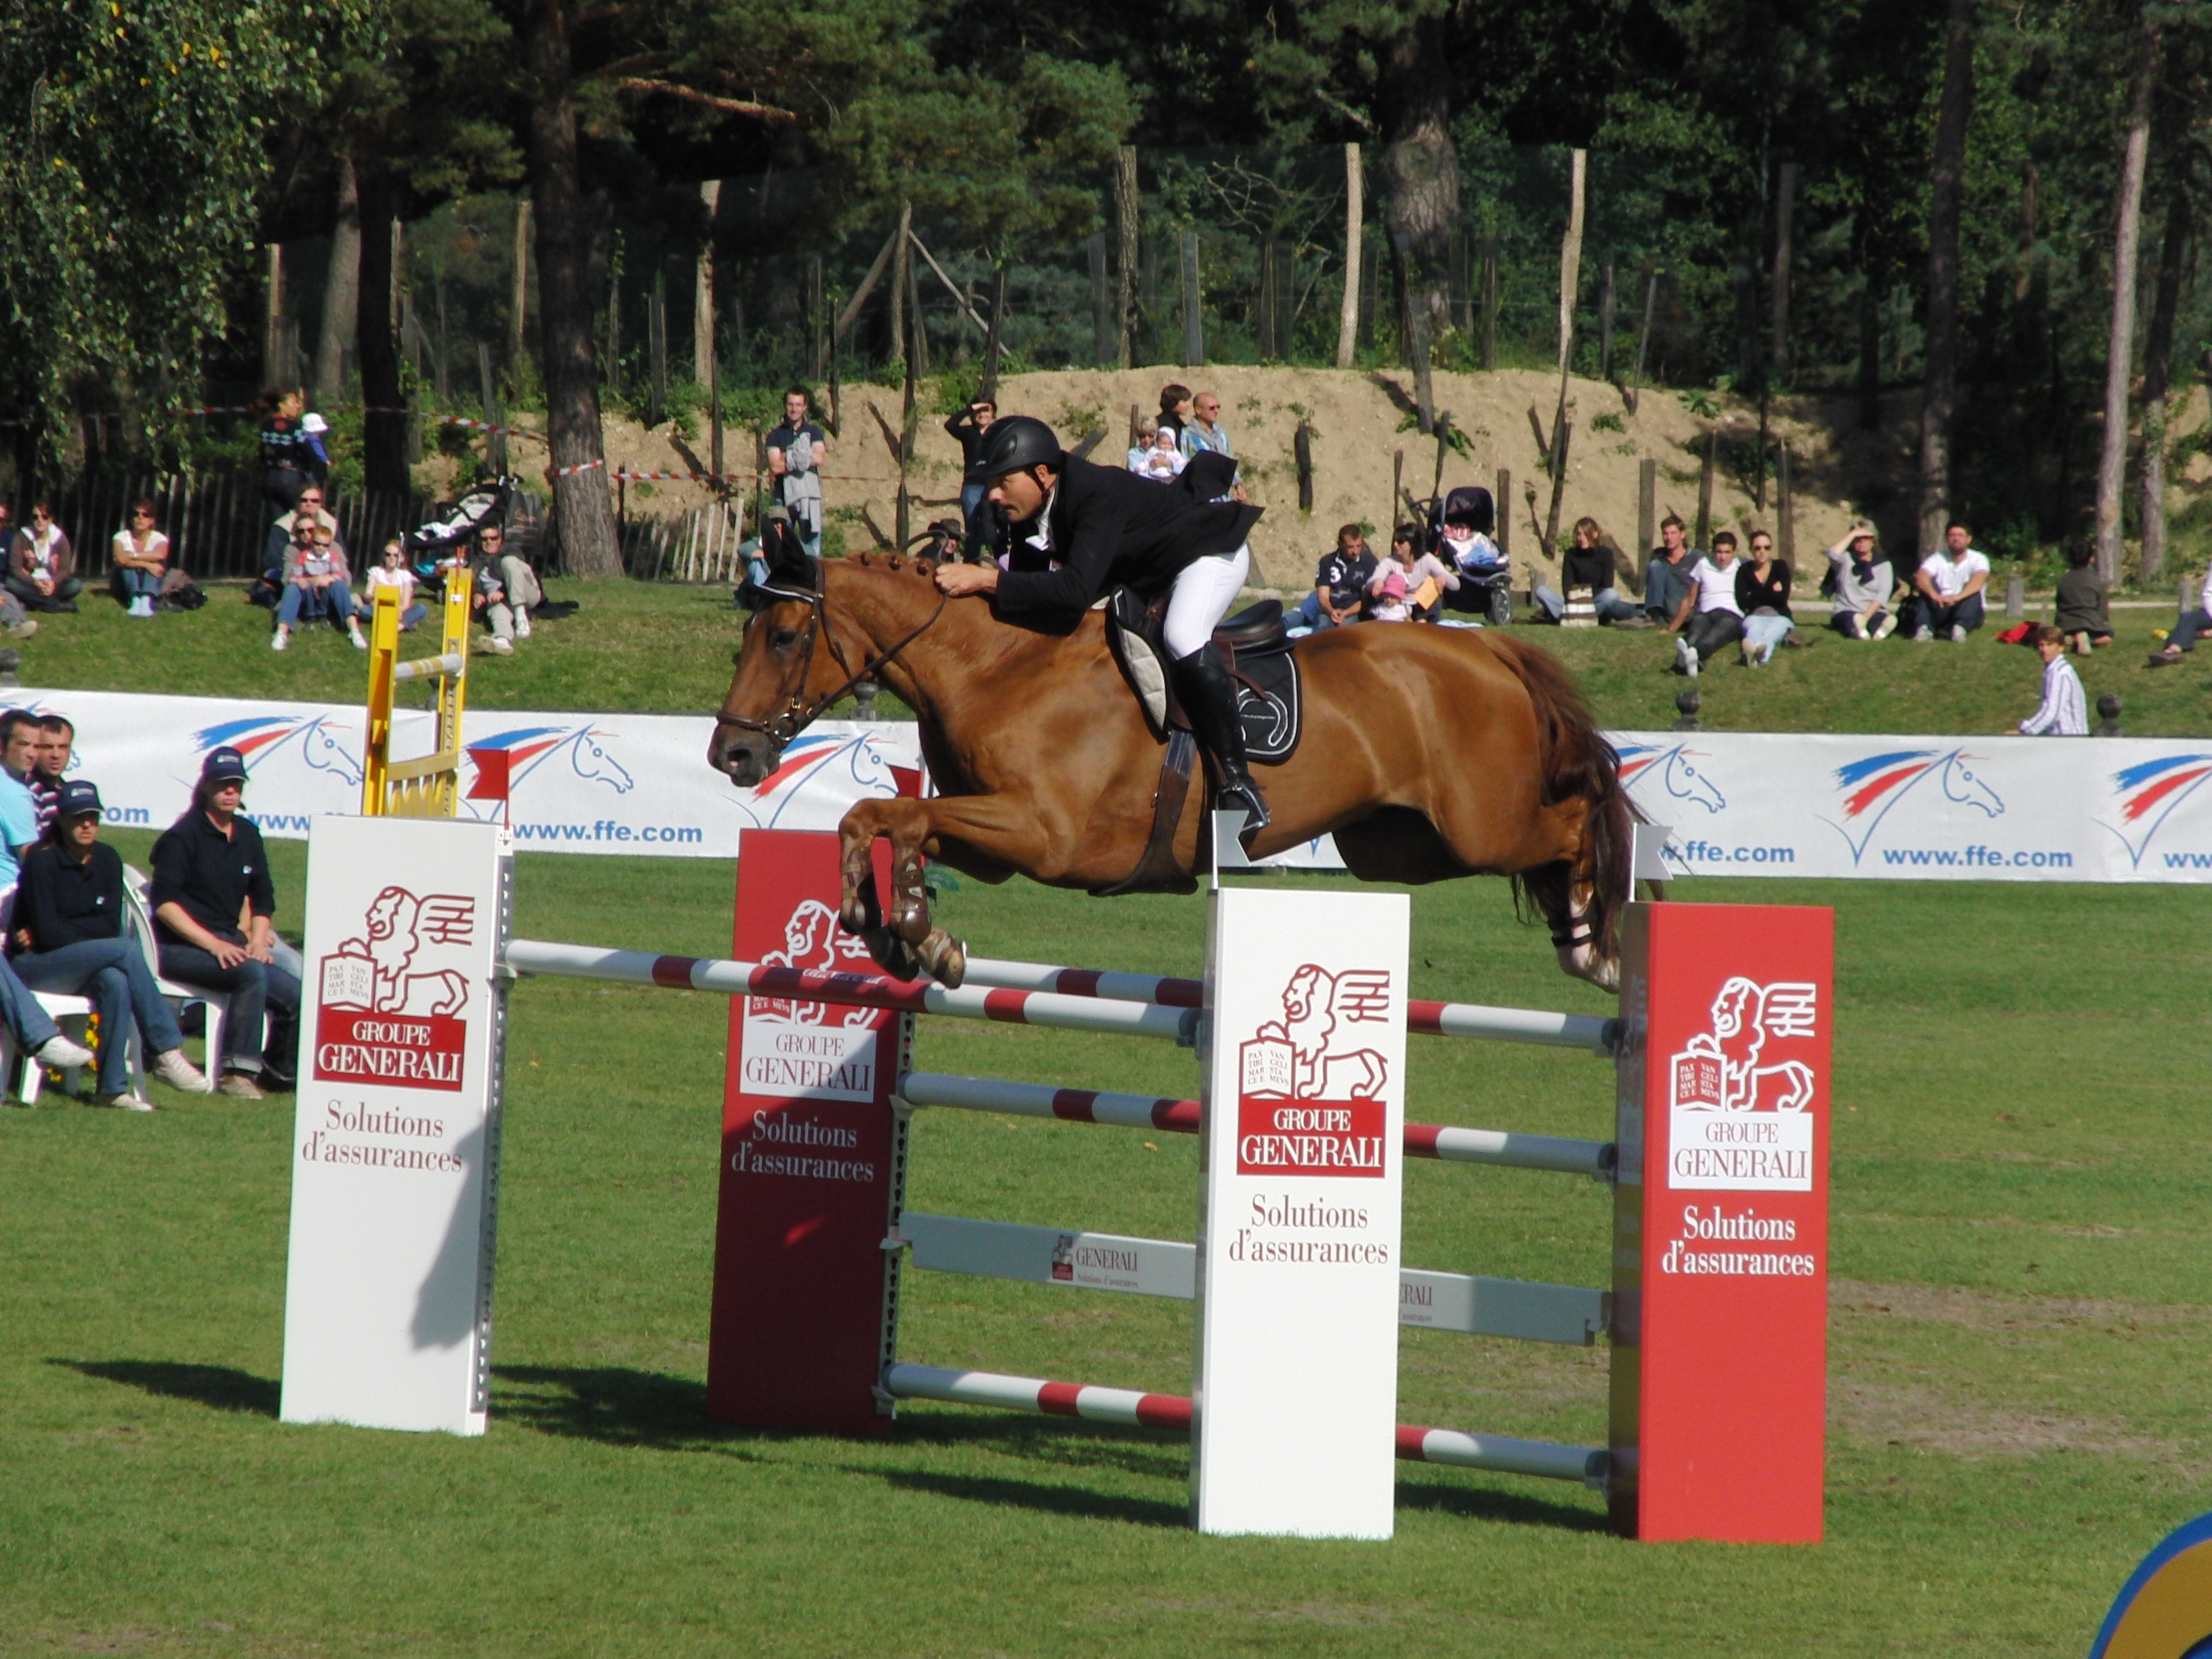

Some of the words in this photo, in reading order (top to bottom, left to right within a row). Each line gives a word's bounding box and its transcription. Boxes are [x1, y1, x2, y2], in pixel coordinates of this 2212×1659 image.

[1329, 565, 1342, 583] 3
[512, 820, 702, 843] www.ffe.com
[1883, 845, 2073, 868] www.ffe.com
[352, 1019, 431, 1047] GROUPE
[775, 1033, 845, 1058] GROUPE
[318, 1043, 461, 1082] GENERALI
[745, 1056, 869, 1092] GENERALI
[325, 1098, 443, 1139] Solutions
[752, 1109, 857, 1149] Solutions
[1273, 1108, 1352, 1132] GROUPE
[1705, 1122, 1779, 1144] GROUPE
[302, 1130, 463, 1172] d'assurances
[731, 1141, 874, 1182] d'assurances
[1240, 1135, 1382, 1168] GENERALI
[1674, 1148, 1808, 1180] GENERALI
[1251, 1193, 1368, 1229] Solutions
[1683, 1205, 1796, 1241] Solutions
[1076, 1247, 1138, 1271] GENERALI
[1229, 1229, 1389, 1265] d'assurances
[1662, 1239, 1815, 1276] d'assurances
